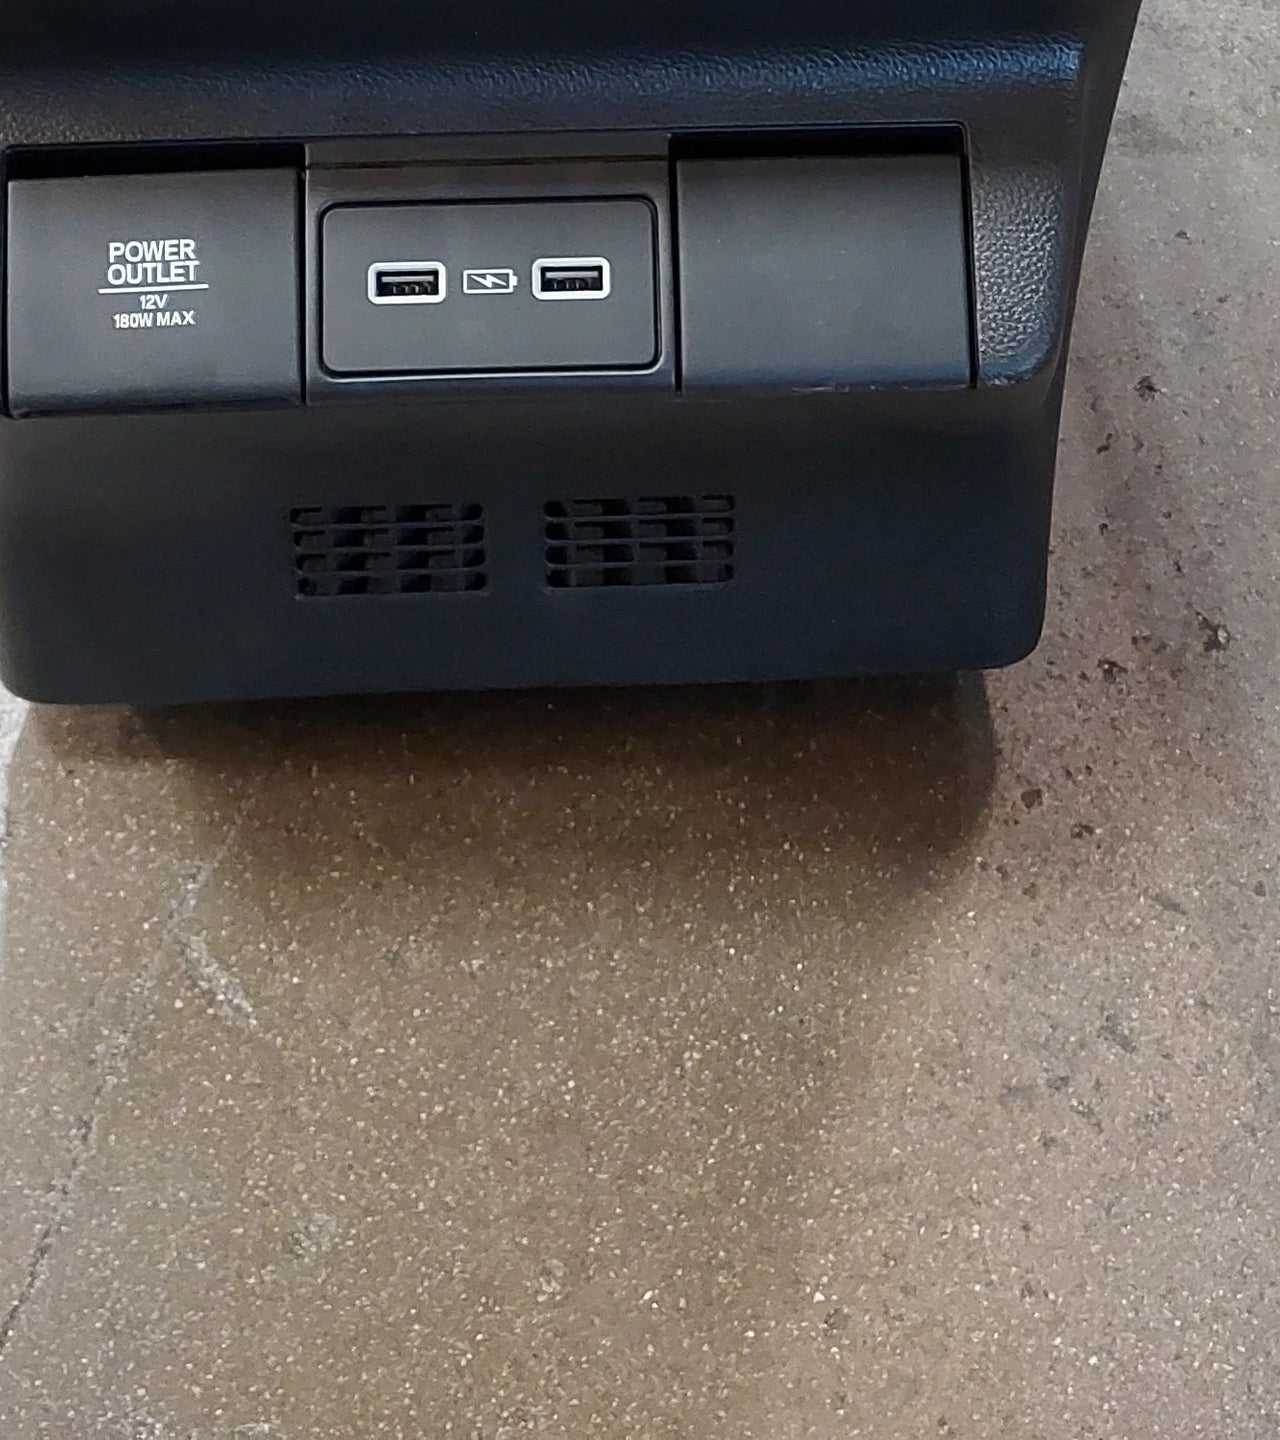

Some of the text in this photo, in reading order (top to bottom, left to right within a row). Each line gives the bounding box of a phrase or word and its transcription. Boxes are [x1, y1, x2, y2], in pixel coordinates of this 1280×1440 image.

[108, 239, 197, 263] POWER
[107, 260, 201, 286] OUTLET
[139, 293, 169, 310] 12V
[113, 310, 197, 329] 180W MAX
